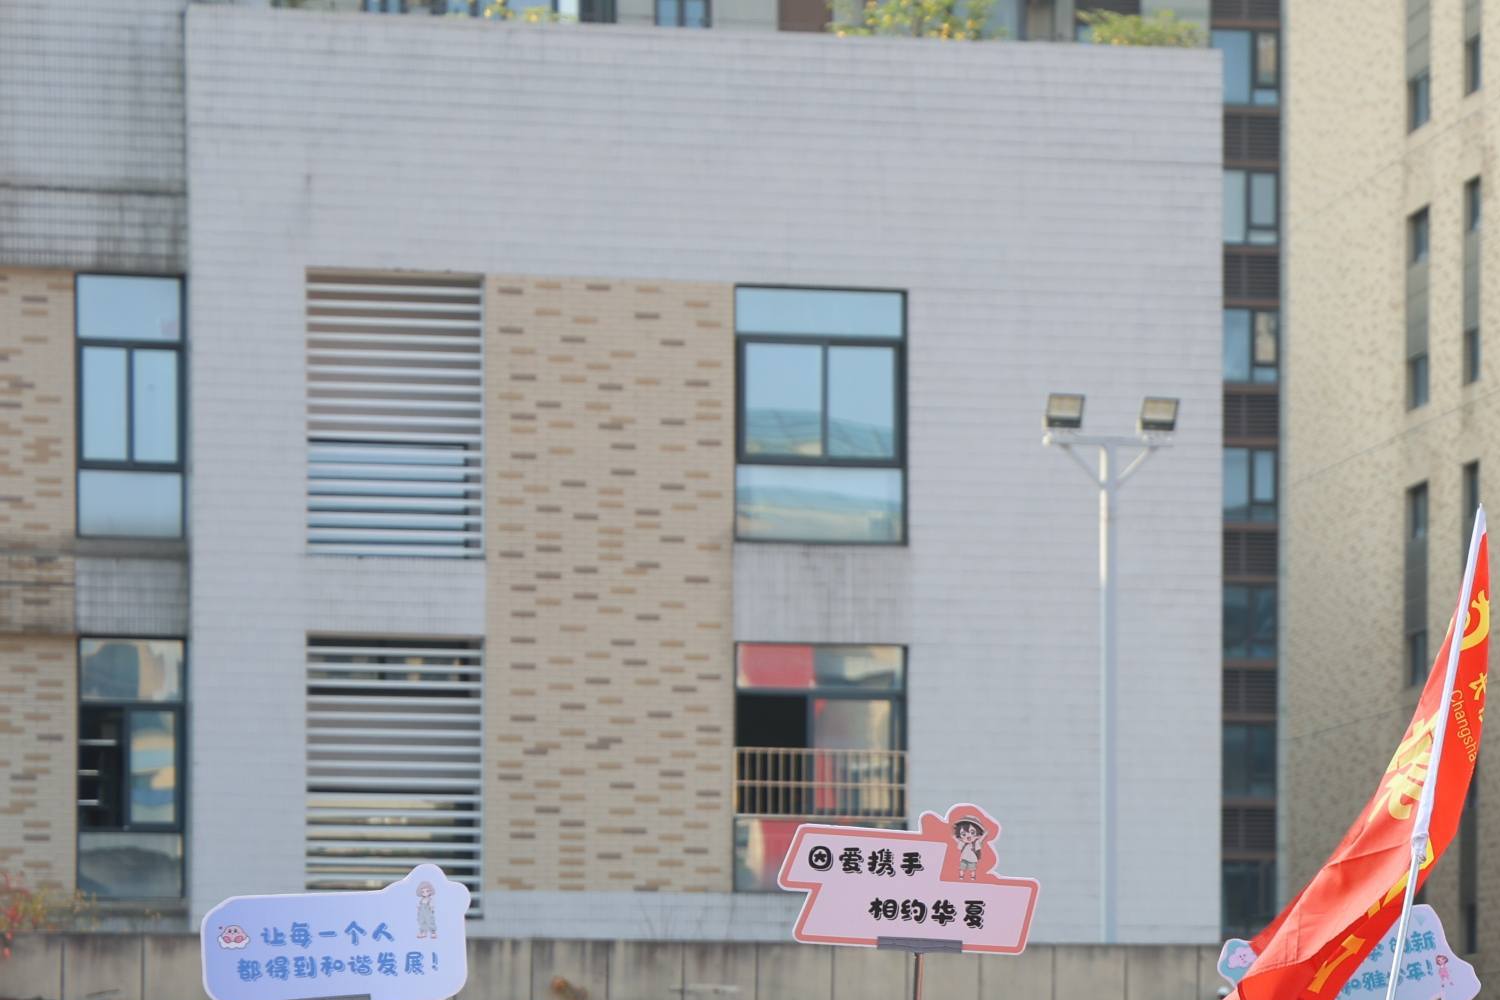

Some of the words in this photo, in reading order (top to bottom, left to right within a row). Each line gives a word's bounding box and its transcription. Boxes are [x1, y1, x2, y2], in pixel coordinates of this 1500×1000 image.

[1450, 689, 1477, 763] Changsha
[808, 845, 924, 877] 因爱携手
[868, 897, 987, 929] 相约华夏
[260, 921, 396, 949] 让每一个人
[236, 951, 440, 983] 都得到和谐发展！
